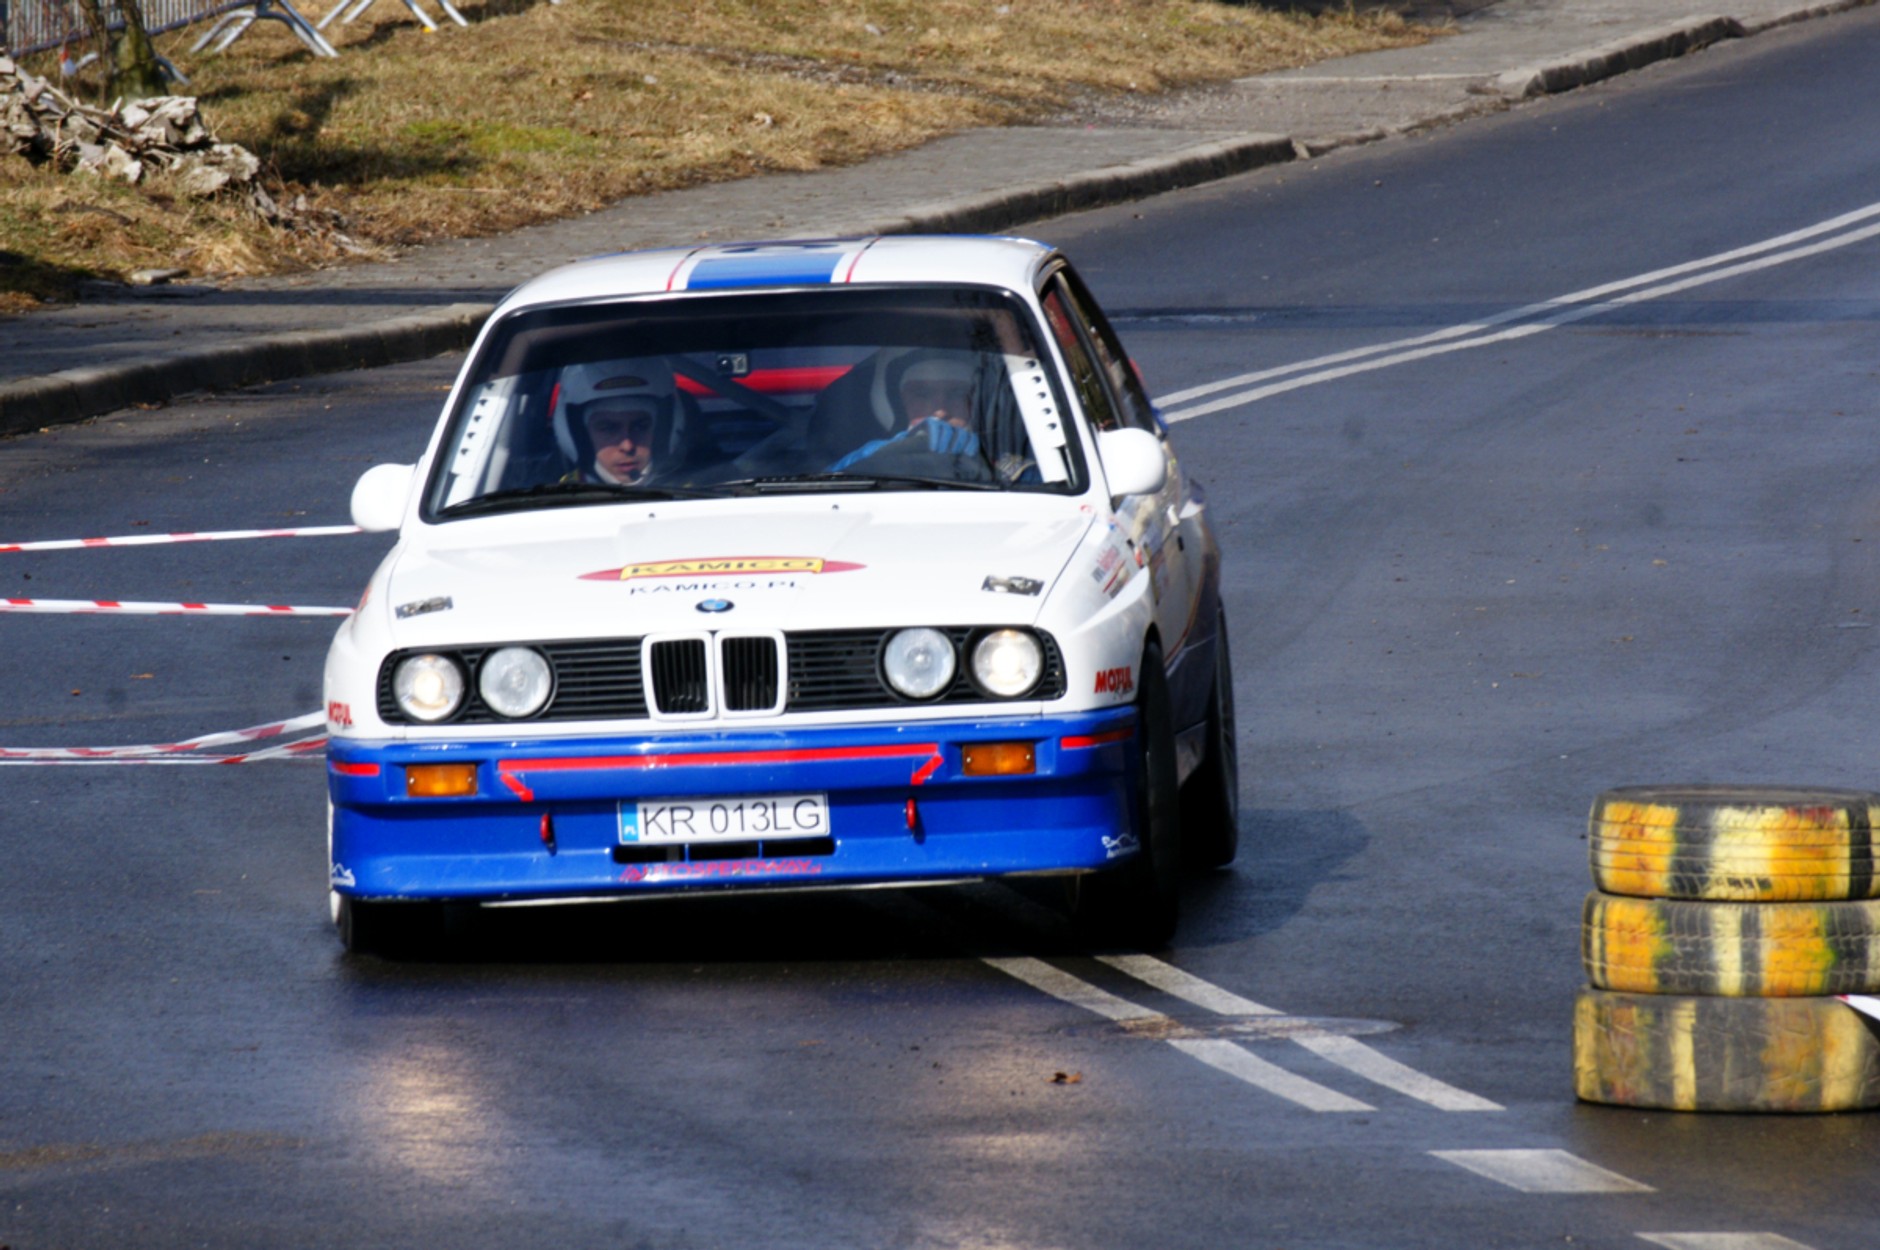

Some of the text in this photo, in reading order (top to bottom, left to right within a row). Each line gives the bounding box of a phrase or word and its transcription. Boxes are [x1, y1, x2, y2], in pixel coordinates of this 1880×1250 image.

[631, 560, 815, 575] KAMICO
[1094, 666, 1134, 694] MOTUL
[642, 798, 821, 836] KR 013LG
